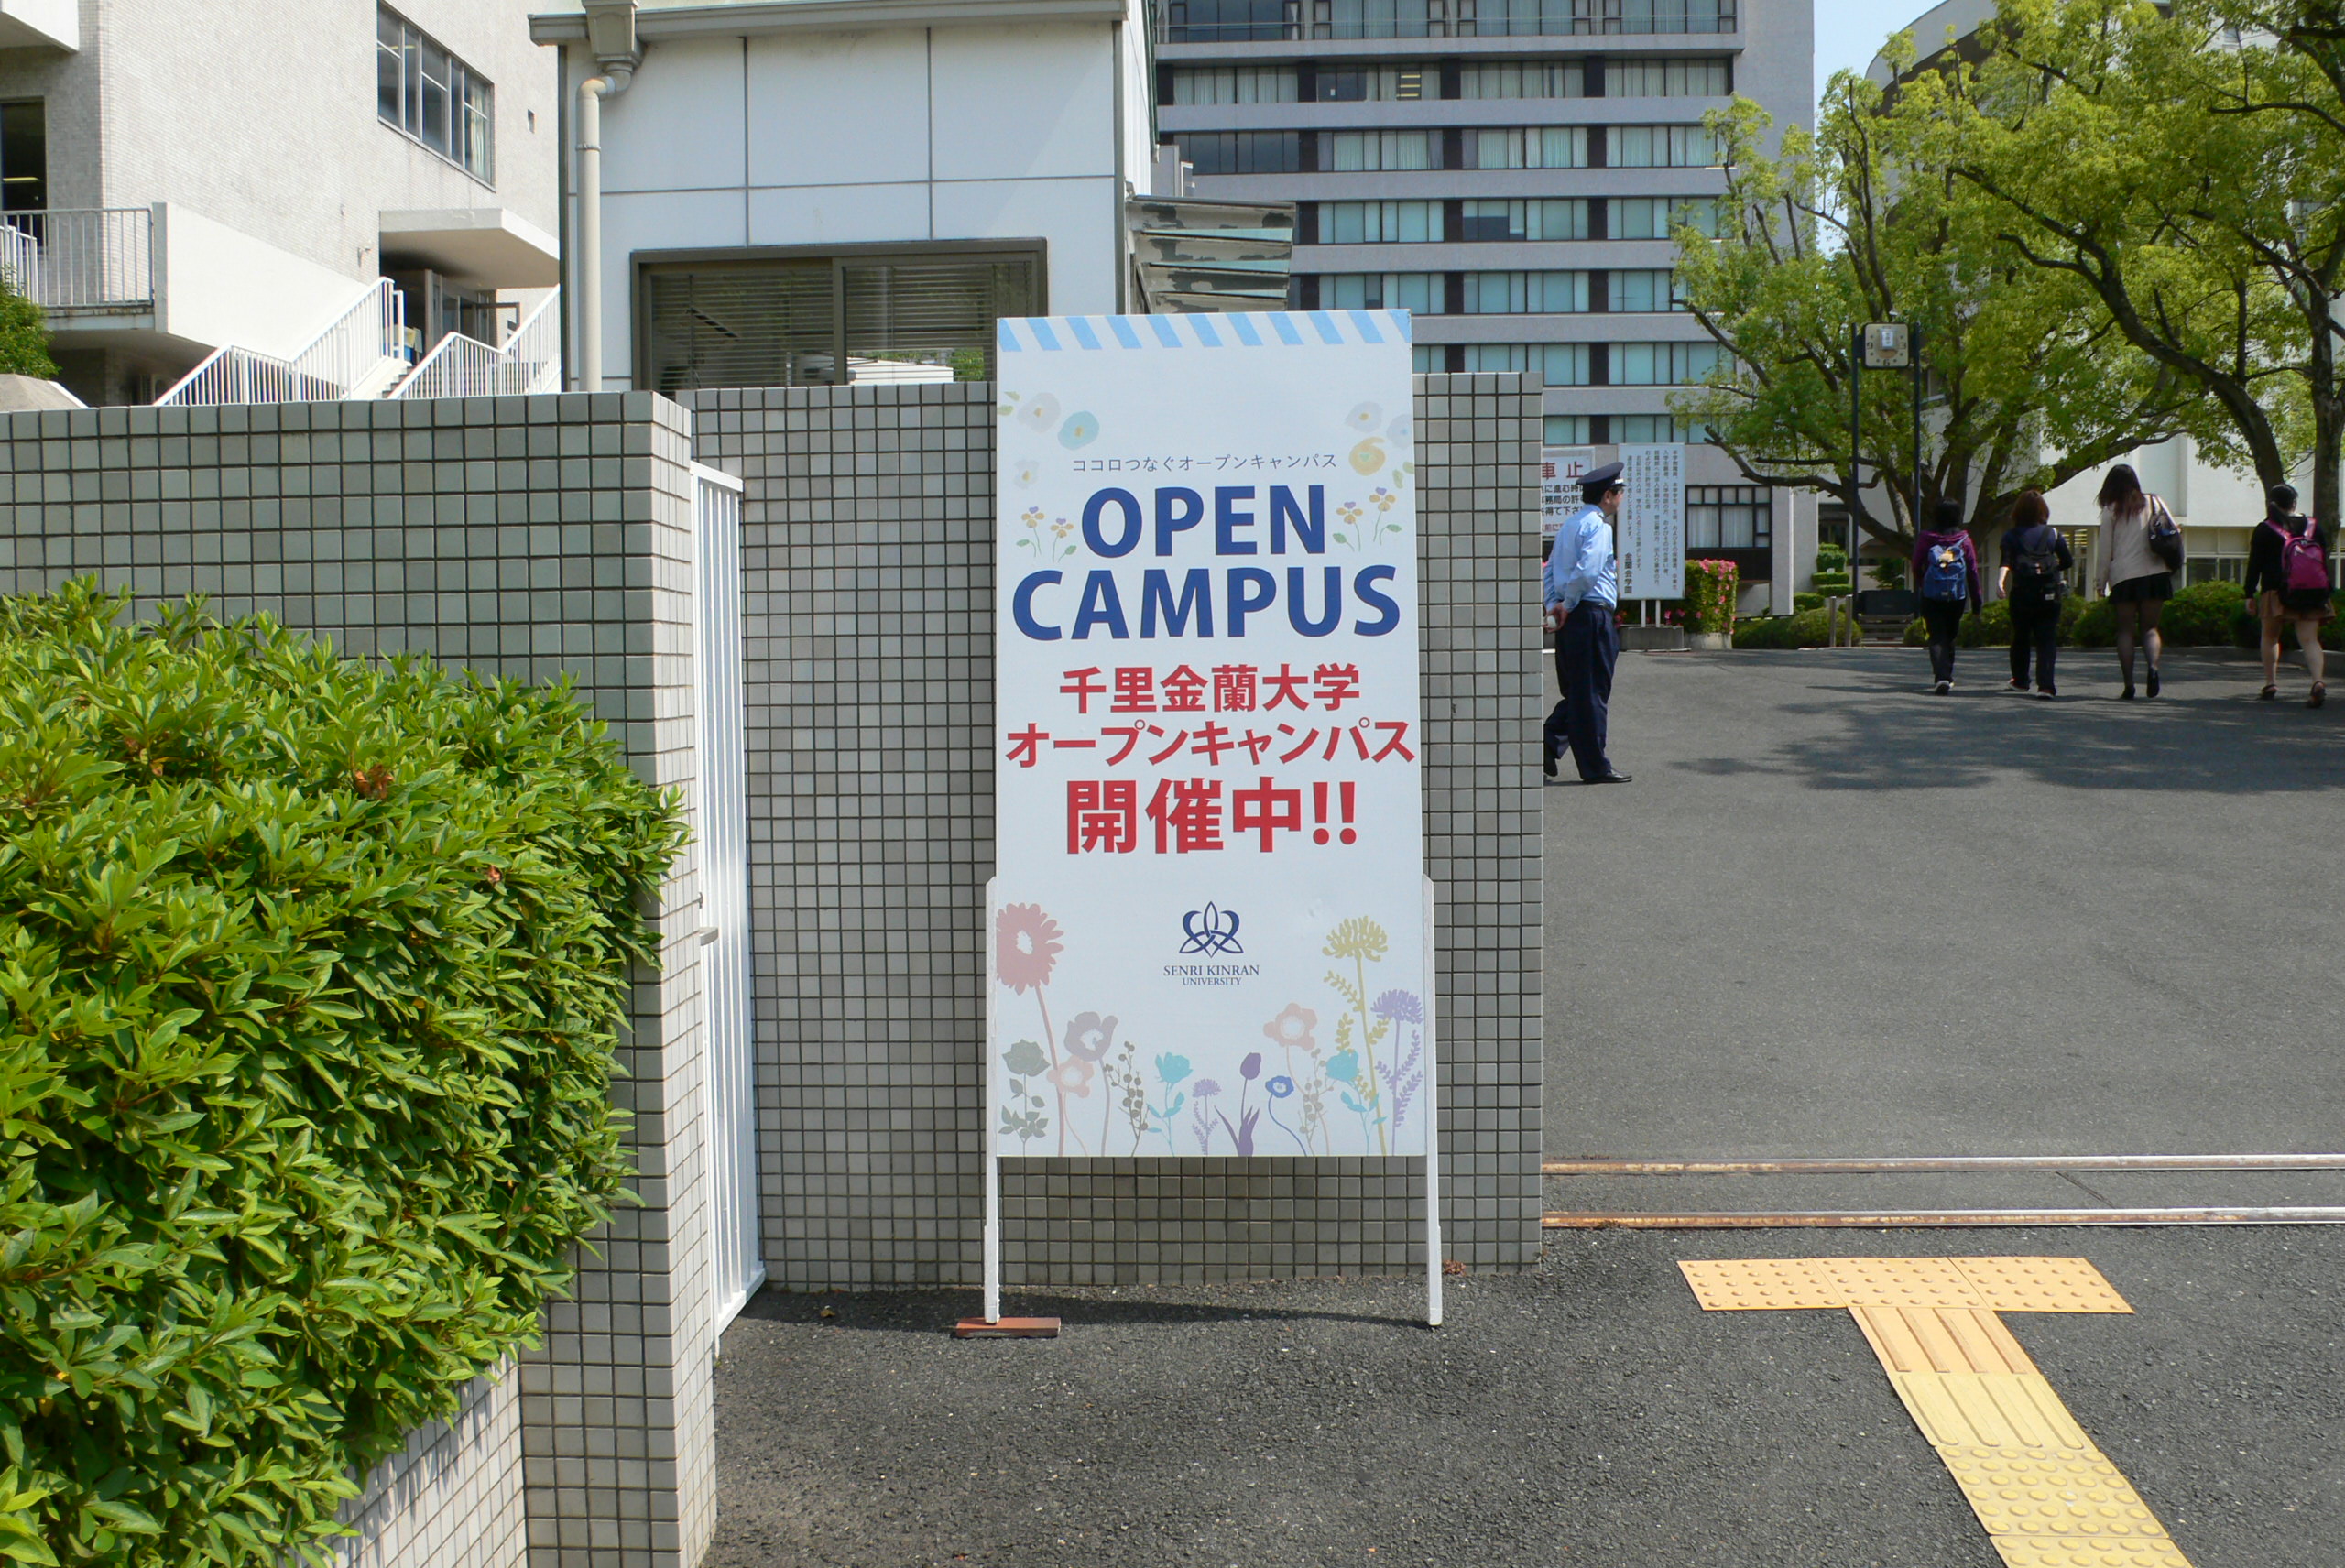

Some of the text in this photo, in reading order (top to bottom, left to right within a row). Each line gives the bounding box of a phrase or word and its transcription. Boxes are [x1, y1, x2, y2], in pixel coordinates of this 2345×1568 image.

[1073, 454, 1337, 472] ココロつなぐオープンキャンパス
[1082, 485, 1325, 558] OPEN
[1012, 564, 1401, 641] CAMPUS
[1059, 663, 1360, 714] 千里金蘭大学
[1006, 717, 1415, 768] オープンキャンパス
[1066, 776, 1357, 855] 開催中!!
[1163, 964, 1260, 976] SENRI KINRAN
[1182, 977, 1242, 985] UNIVERSITY
